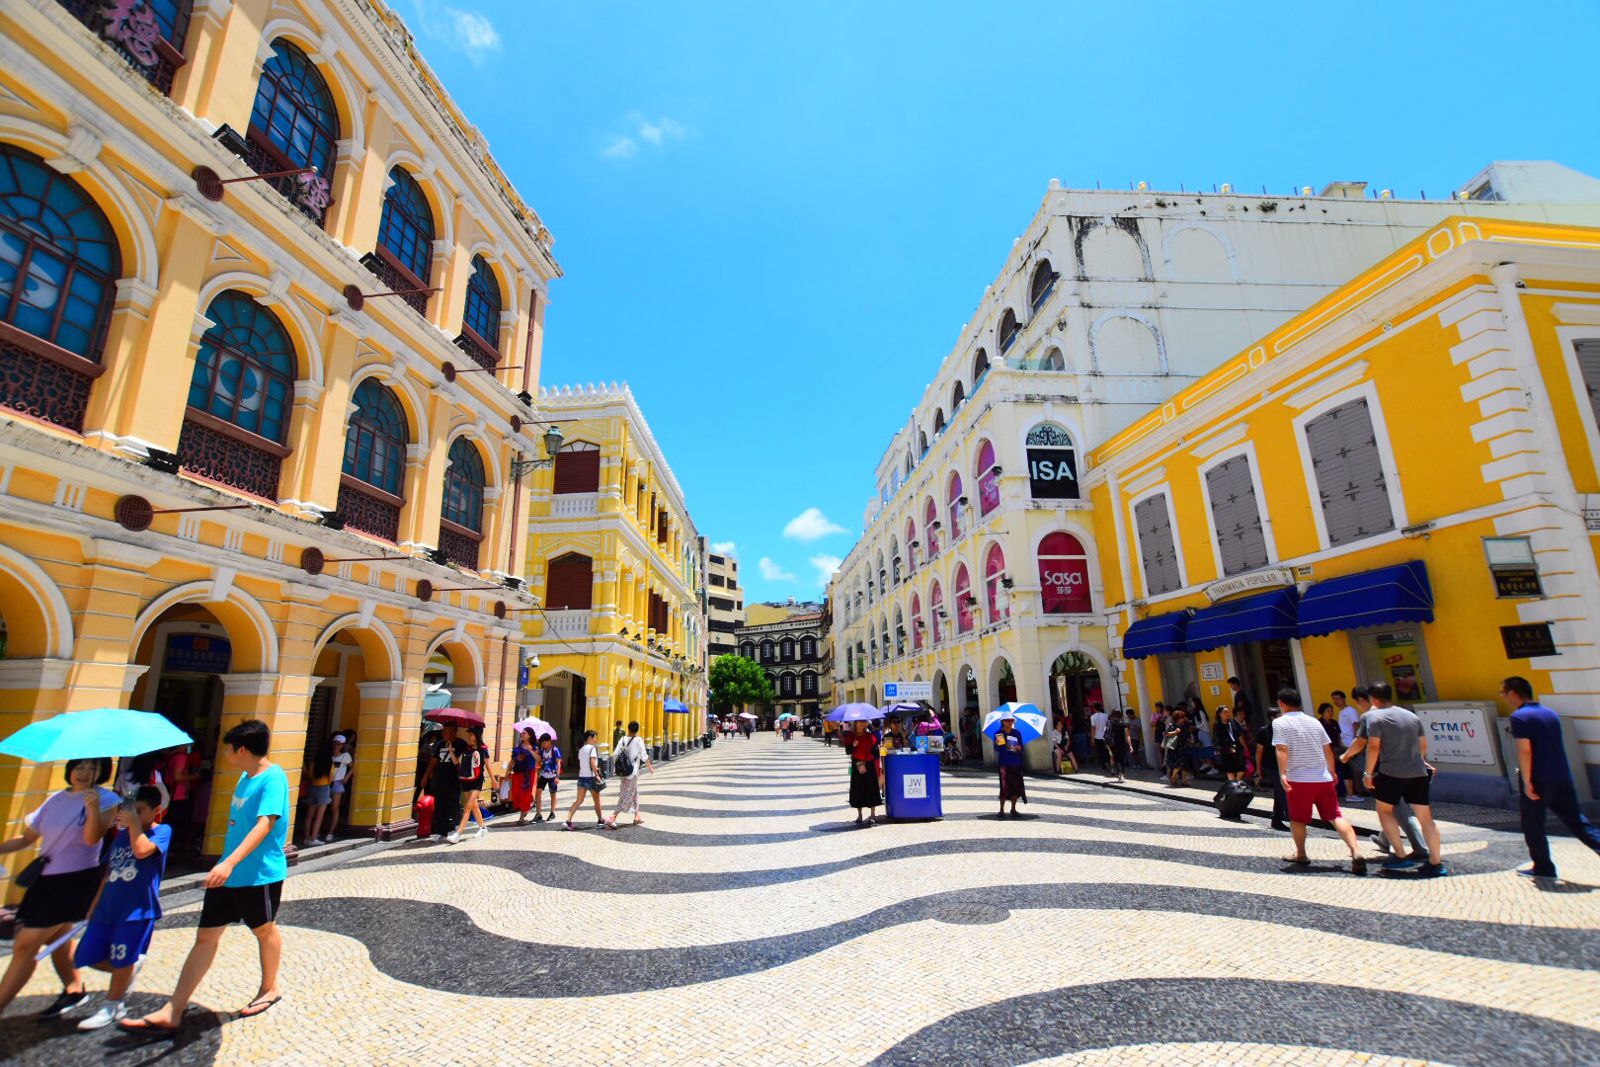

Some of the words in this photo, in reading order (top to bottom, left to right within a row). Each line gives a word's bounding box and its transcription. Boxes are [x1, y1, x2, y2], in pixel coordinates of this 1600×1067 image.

[1031, 460, 1075, 481] ISA
[1245, 573, 1278, 586] POPULAR
[1431, 722, 1459, 731] CTM
[908, 778, 922, 787] JW
